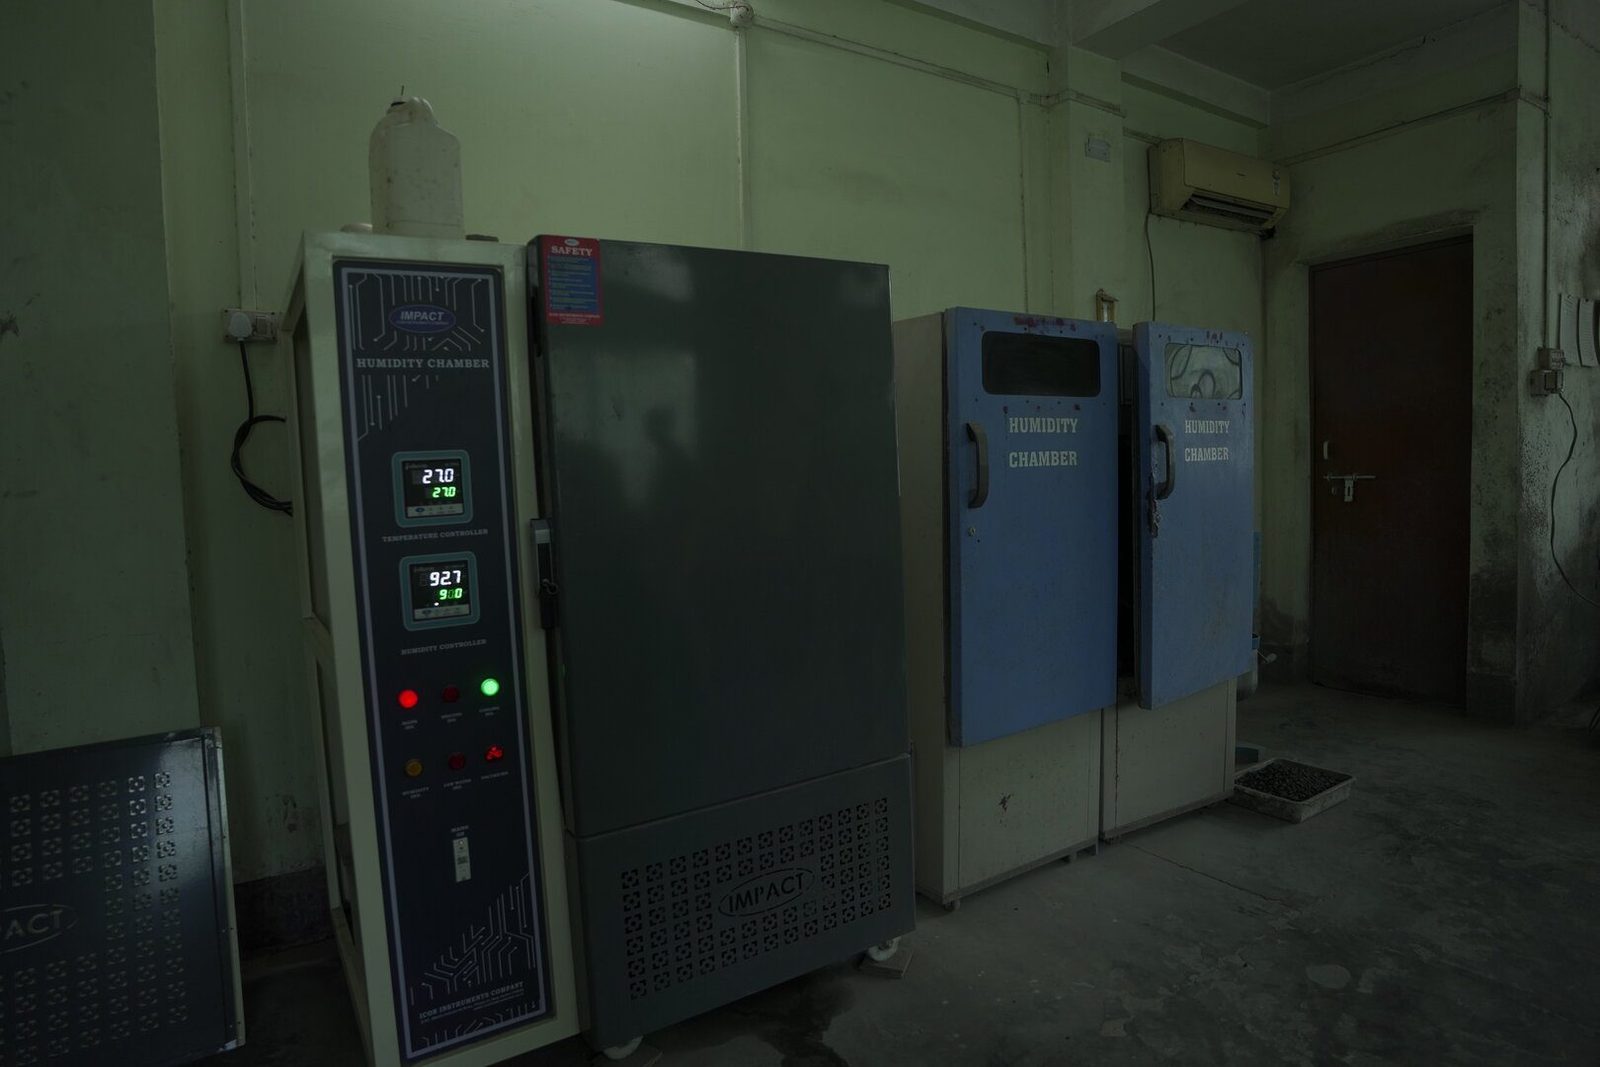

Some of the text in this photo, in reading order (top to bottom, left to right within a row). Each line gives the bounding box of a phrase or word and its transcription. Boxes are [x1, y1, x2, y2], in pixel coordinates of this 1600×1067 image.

[551, 246, 592, 256] SAFETY
[400, 311, 445, 321] IMPACT
[356, 358, 490, 369] HUMIDITY CHAMBER
[1009, 417, 1078, 434] HUMIDITY
[1184, 419, 1230, 434] HUMIDITY
[1008, 450, 1078, 468] CHAMBER
[1184, 447, 1229, 463] CHAMBER
[382, 528, 488, 542] TEMPERATURE CONTROLLER
[400, 639, 487, 656] HUMIDITY CONTROLLER
[729, 873, 804, 912] IMPACT
[439, 992, 489, 1012] INSTRUMENTS
[490, 981, 524, 997] COMPANY
